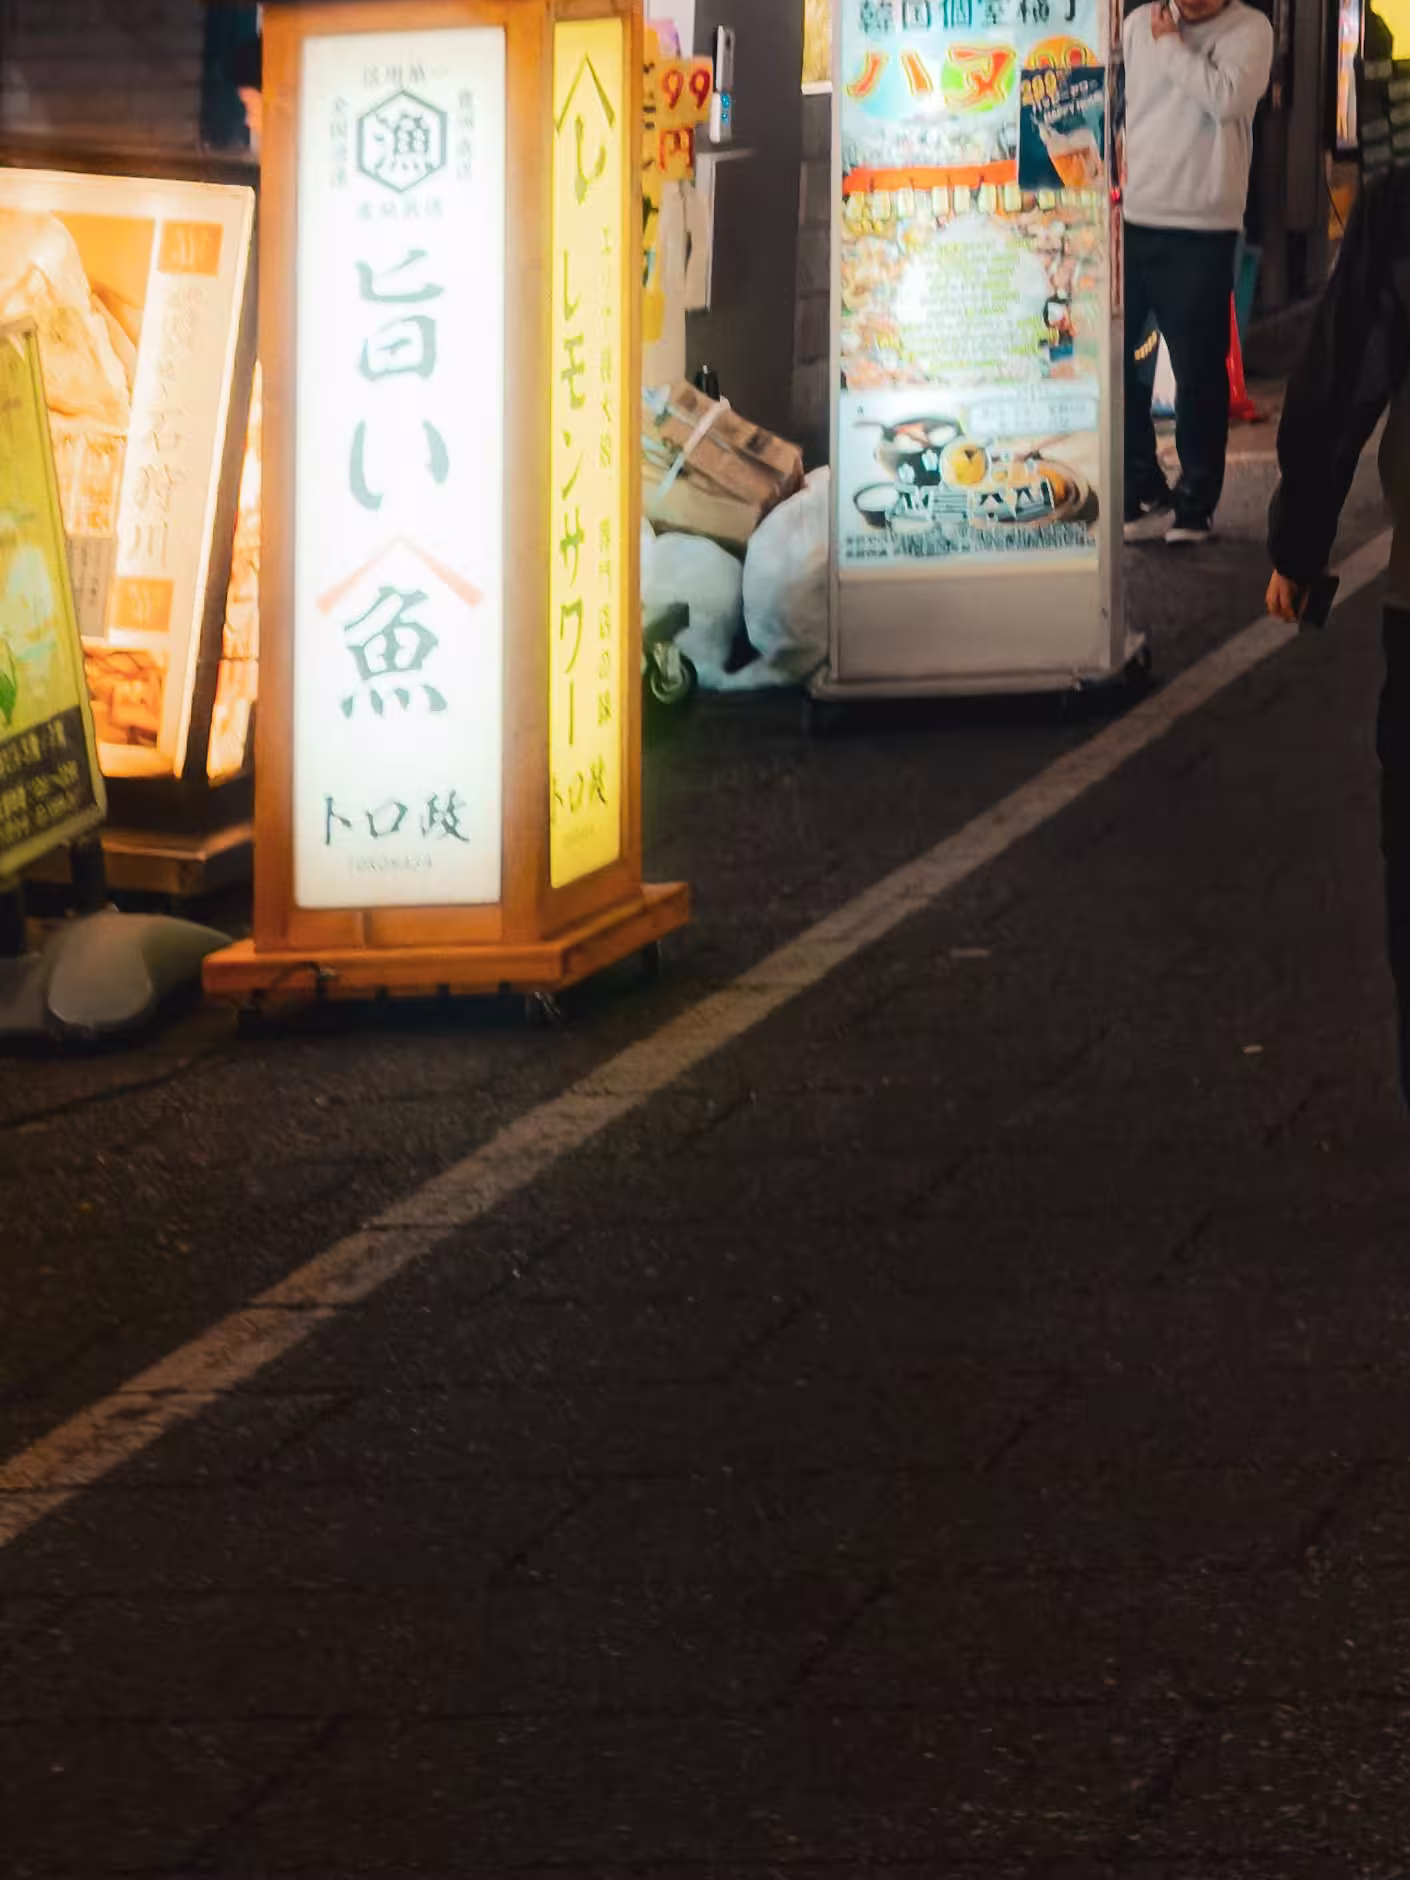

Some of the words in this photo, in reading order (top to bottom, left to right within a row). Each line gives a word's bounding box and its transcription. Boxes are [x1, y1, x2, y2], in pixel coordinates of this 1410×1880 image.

[373, 111, 436, 173] 漁
[341, 248, 451, 720] 旨い魚
[560, 248, 587, 746] レモンサワー
[324, 790, 470, 847] トロ政
